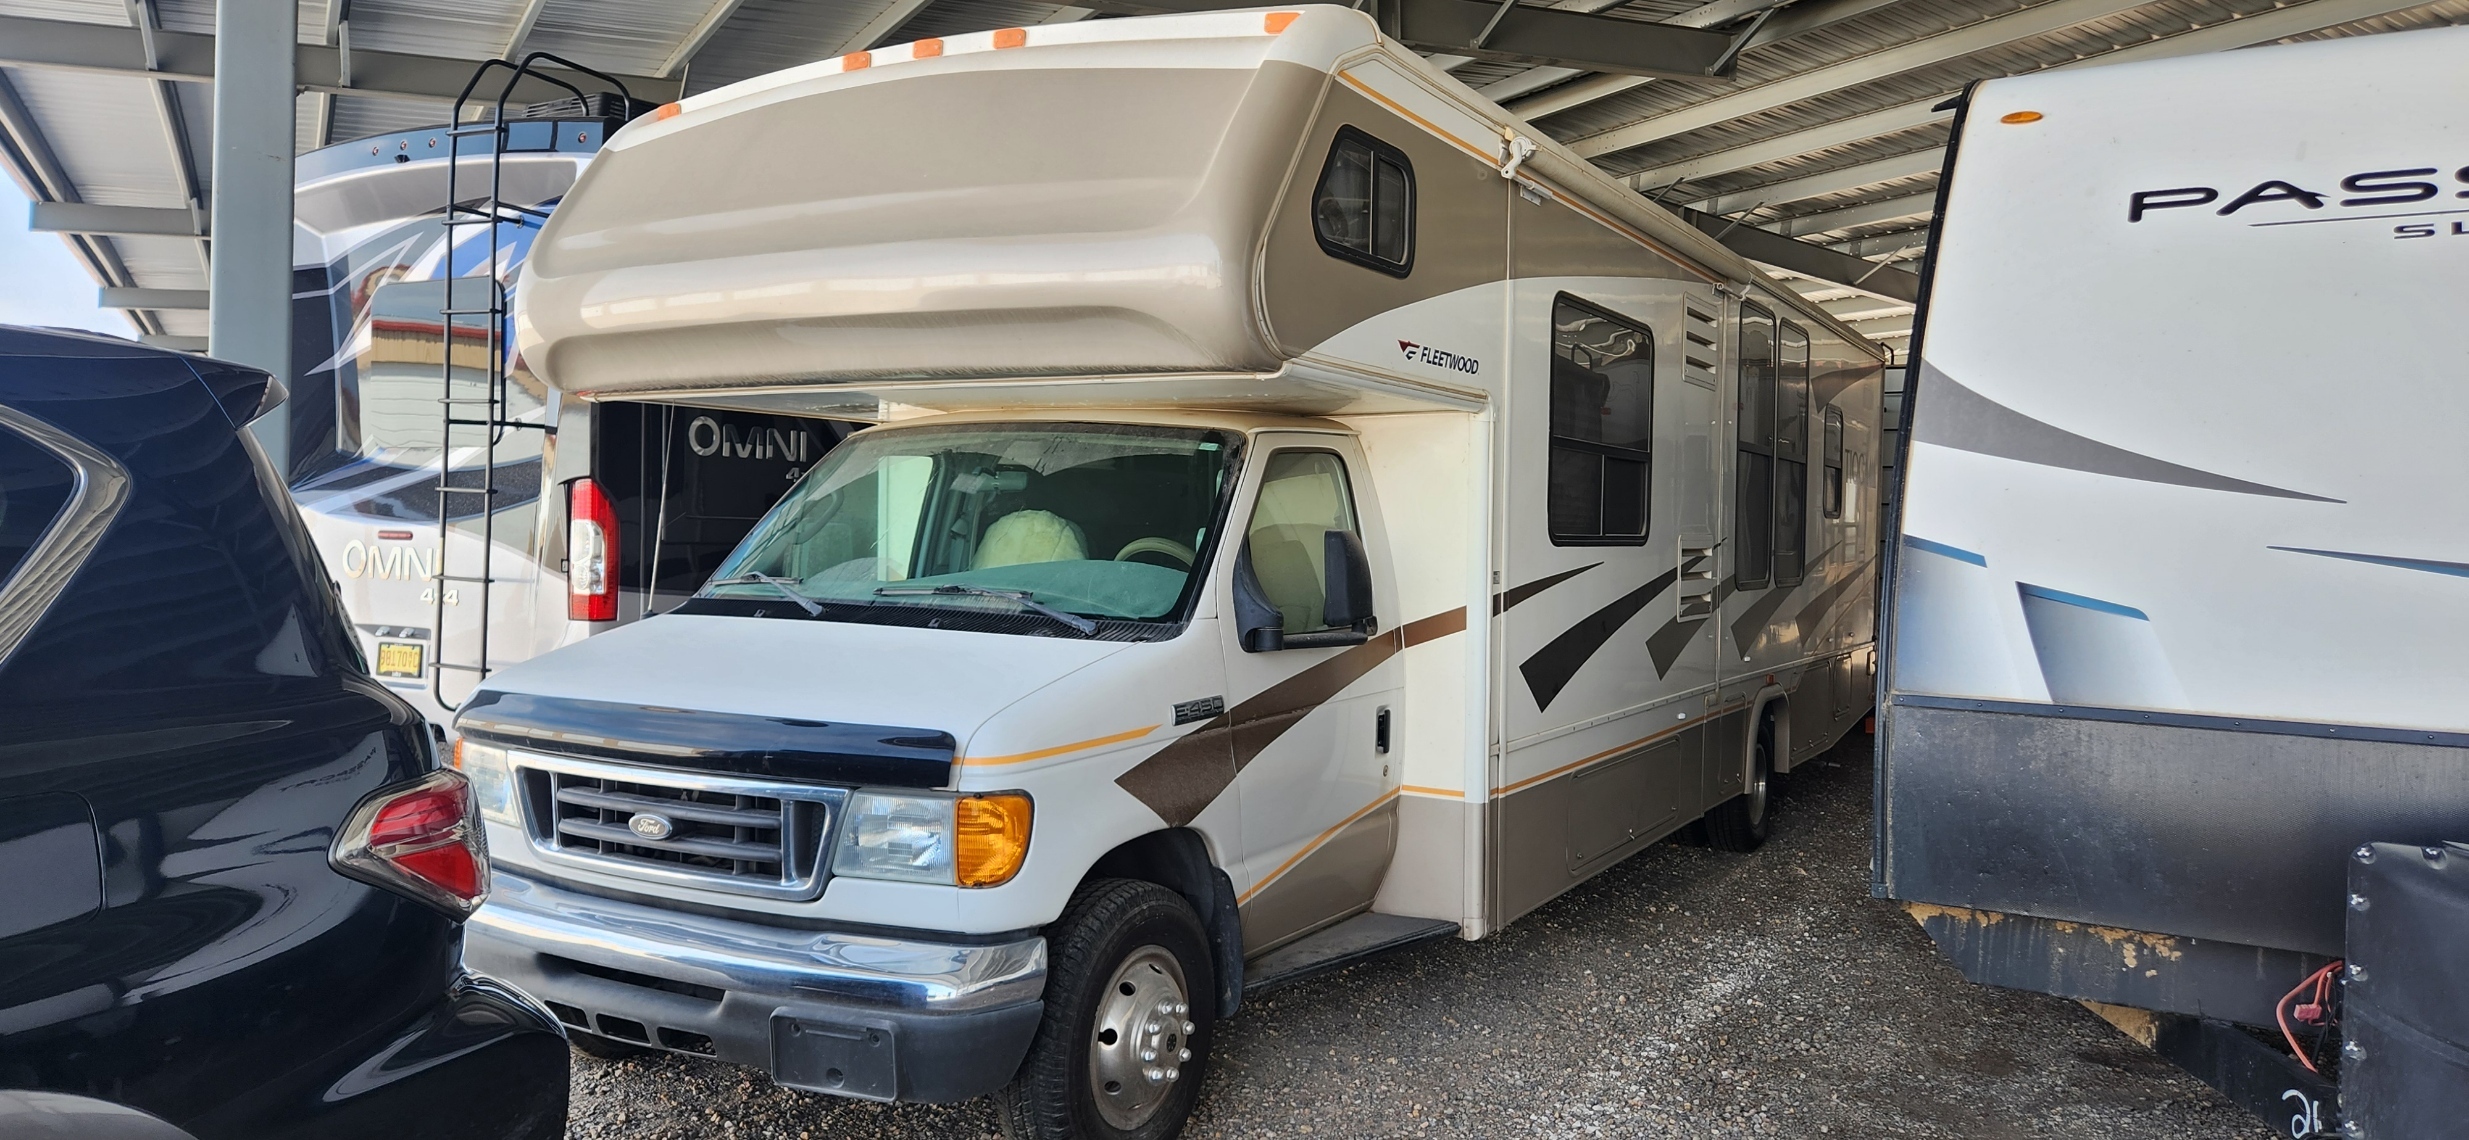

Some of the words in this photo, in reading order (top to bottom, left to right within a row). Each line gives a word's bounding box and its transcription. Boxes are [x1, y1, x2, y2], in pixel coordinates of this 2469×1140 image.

[2127, 166, 2469, 223] PAS
[1420, 346, 1479, 375] FLEETWOOD
[688, 415, 807, 462] OMNI
[342, 539, 443, 582] OMNI
[638, 818, 661, 834] Ford
